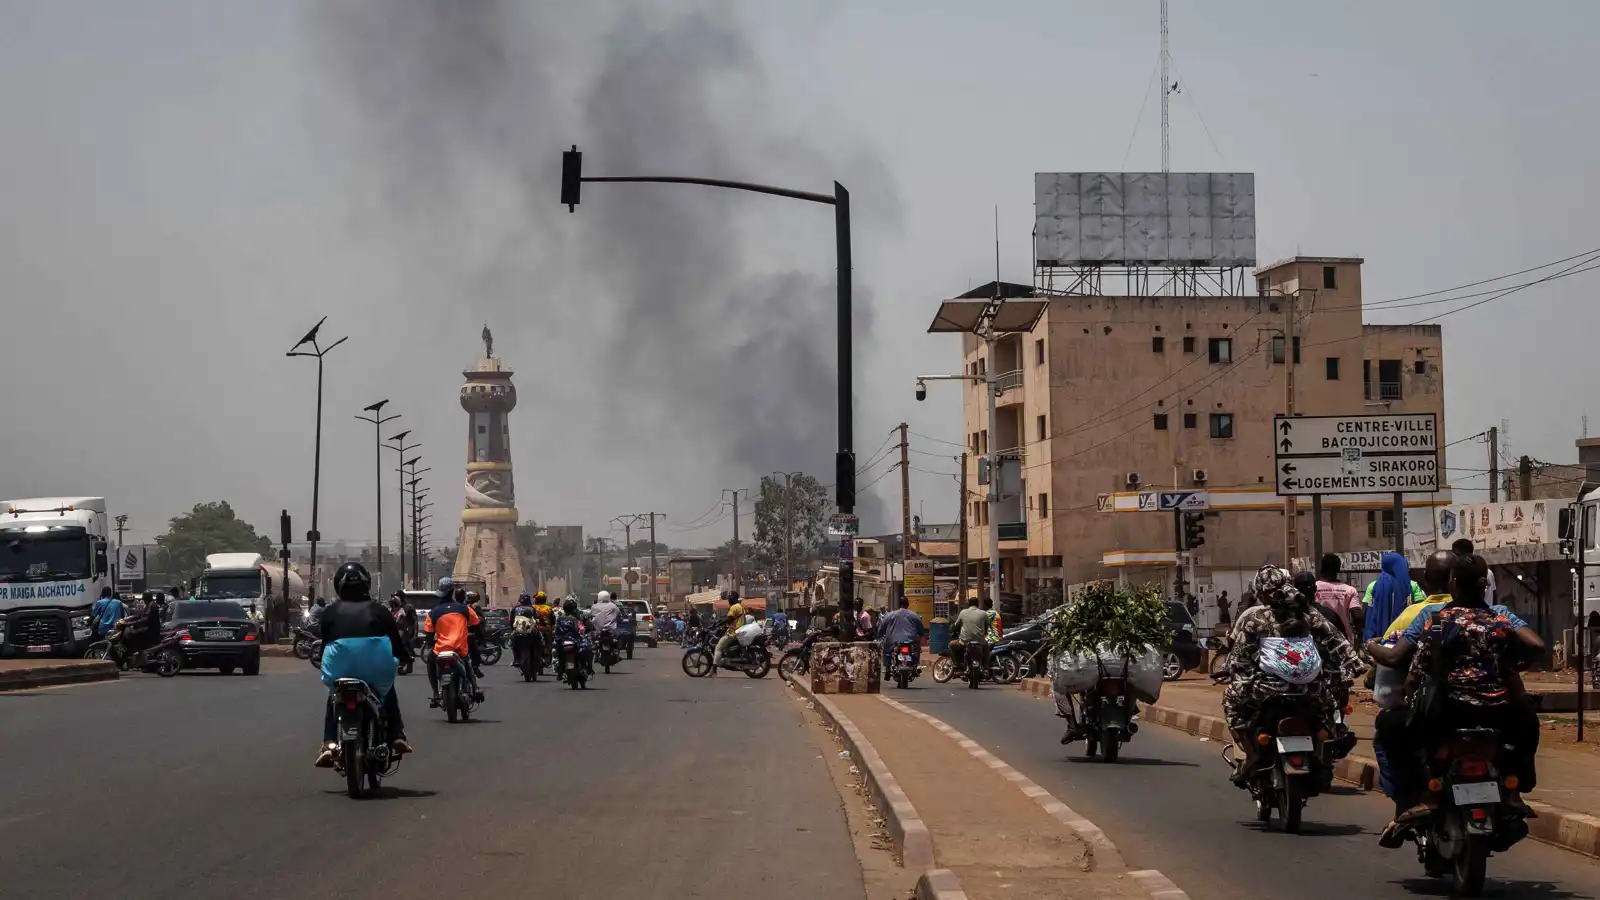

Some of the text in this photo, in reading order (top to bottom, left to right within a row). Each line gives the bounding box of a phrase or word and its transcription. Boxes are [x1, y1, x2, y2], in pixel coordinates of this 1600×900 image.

[1337, 420, 1433, 433] CENTRE-VILLE
[1322, 435, 1433, 448] BACODJICORONI
[1369, 460, 1435, 472] SIRAKORO
[1297, 475, 1436, 489] LOGEMENTS SOCIAUX
[10, 586, 35, 600] MAIGA
[37, 584, 77, 599] AICHATOU
[77, 583, 86, 593] 4
